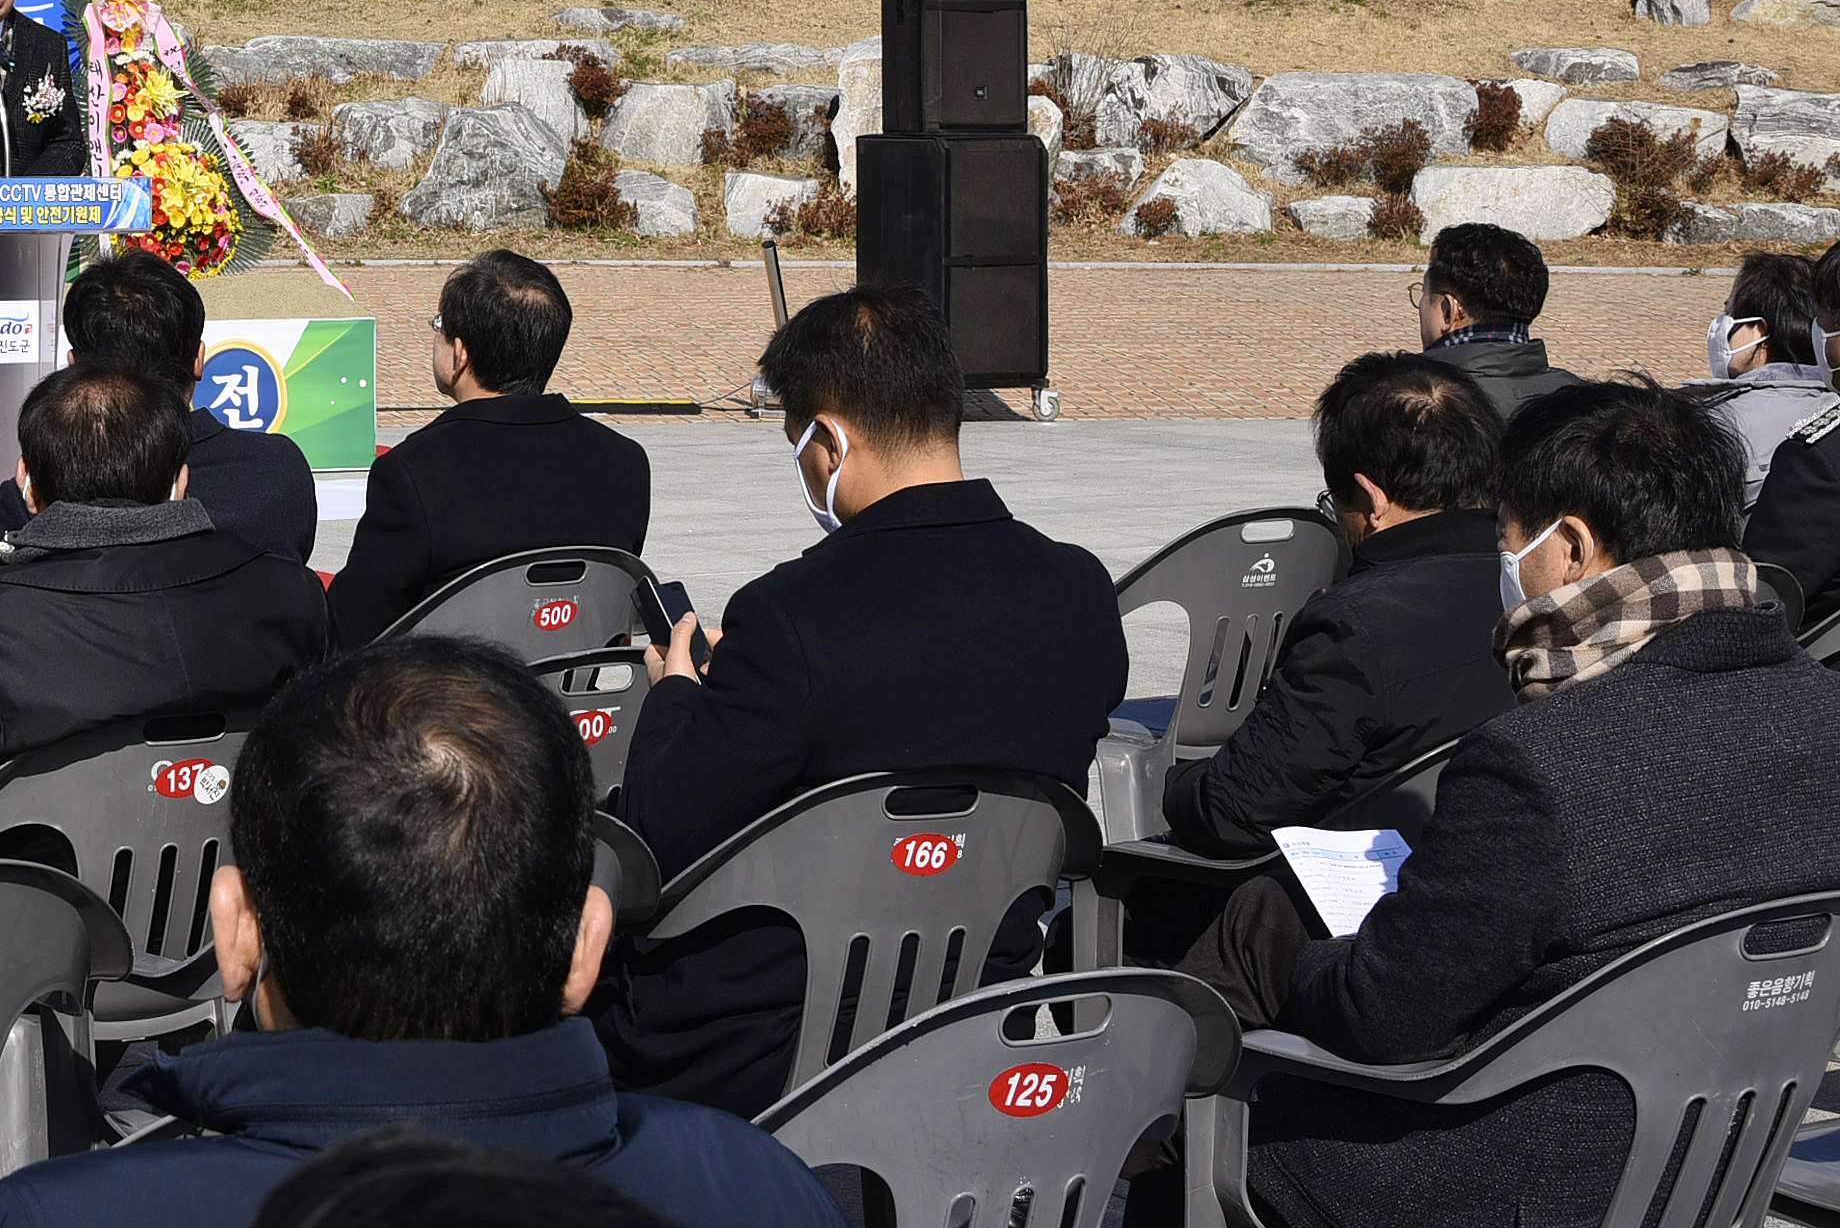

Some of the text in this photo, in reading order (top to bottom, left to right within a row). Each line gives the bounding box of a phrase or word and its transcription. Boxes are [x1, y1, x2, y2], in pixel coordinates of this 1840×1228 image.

[0, 185, 42, 202] CCTV
[44, 183, 122, 203] 통합관제센터
[21, 207, 34, 224] 및
[36, 206, 101, 225] 안전기원제
[212, 365, 264, 429] 전
[539, 604, 572, 627] 500
[579, 715, 604, 741] 00
[167, 763, 205, 793] 137
[904, 840, 949, 869] 166
[1746, 969, 1816, 999] 좋은음향기획
[1004, 1072, 1058, 1107] 125
